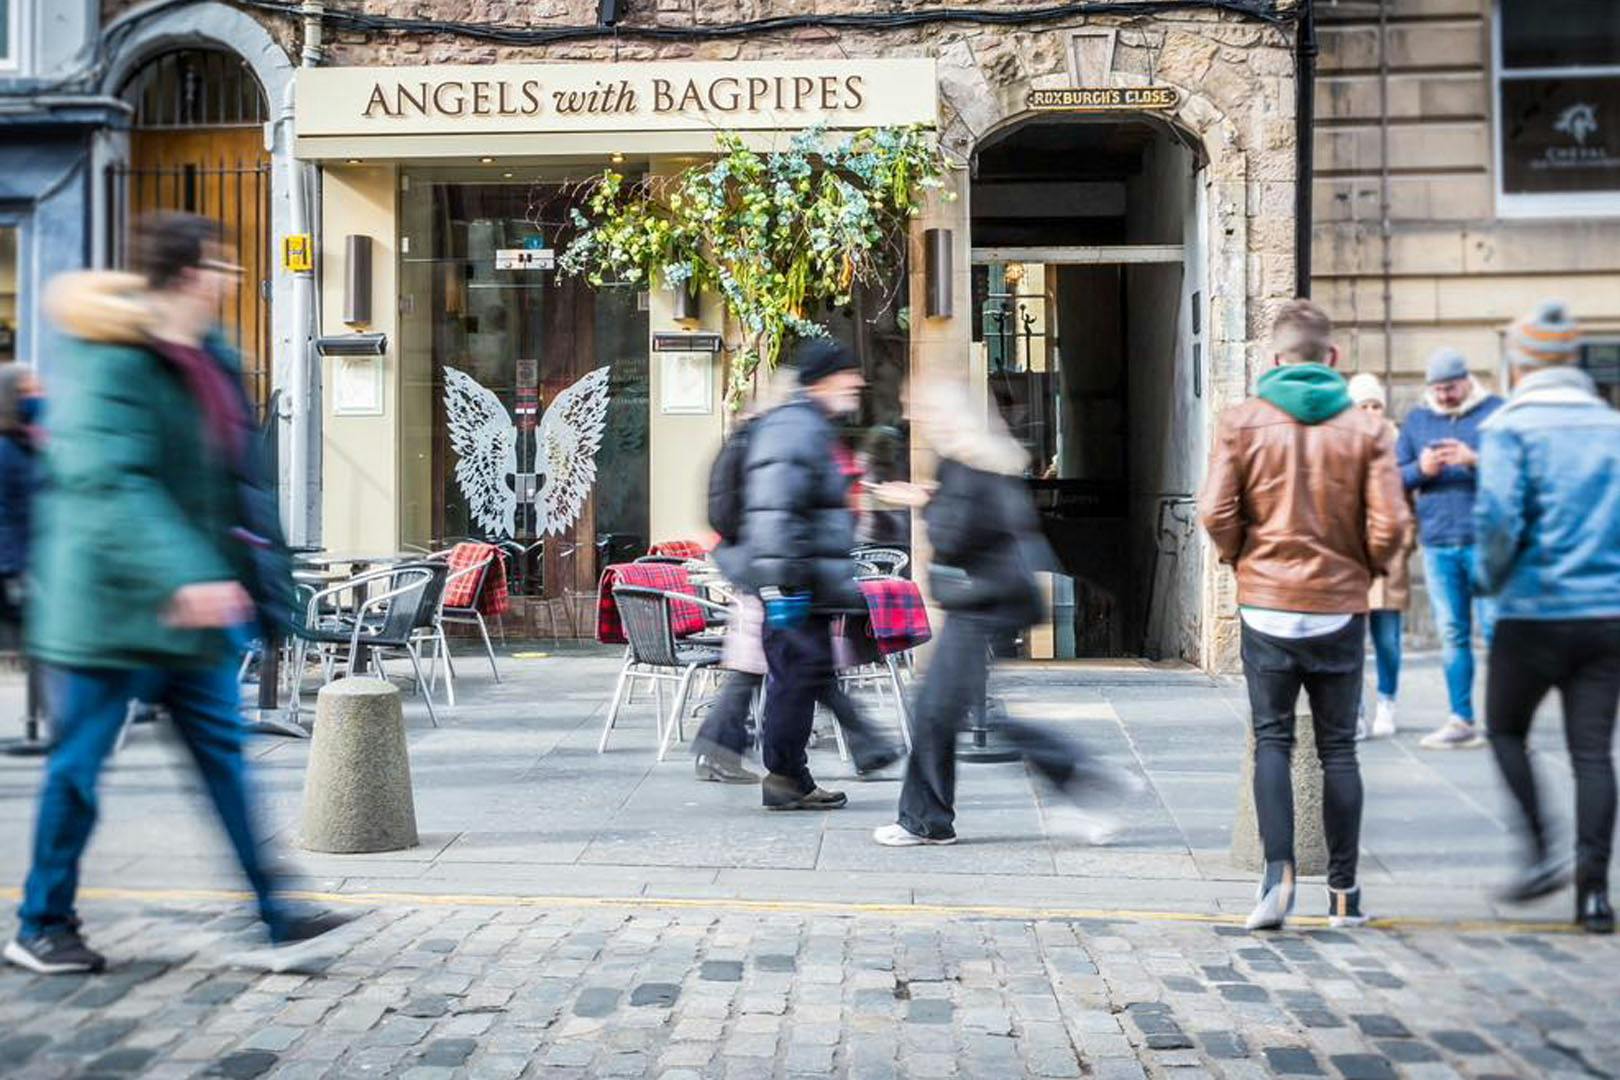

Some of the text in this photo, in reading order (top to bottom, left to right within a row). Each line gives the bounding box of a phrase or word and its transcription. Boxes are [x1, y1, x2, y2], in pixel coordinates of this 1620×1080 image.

[361, 75, 864, 117] ANGELS with BAGPIPES
[1034, 89, 1170, 105] ROXBURGH'S CLOSE
